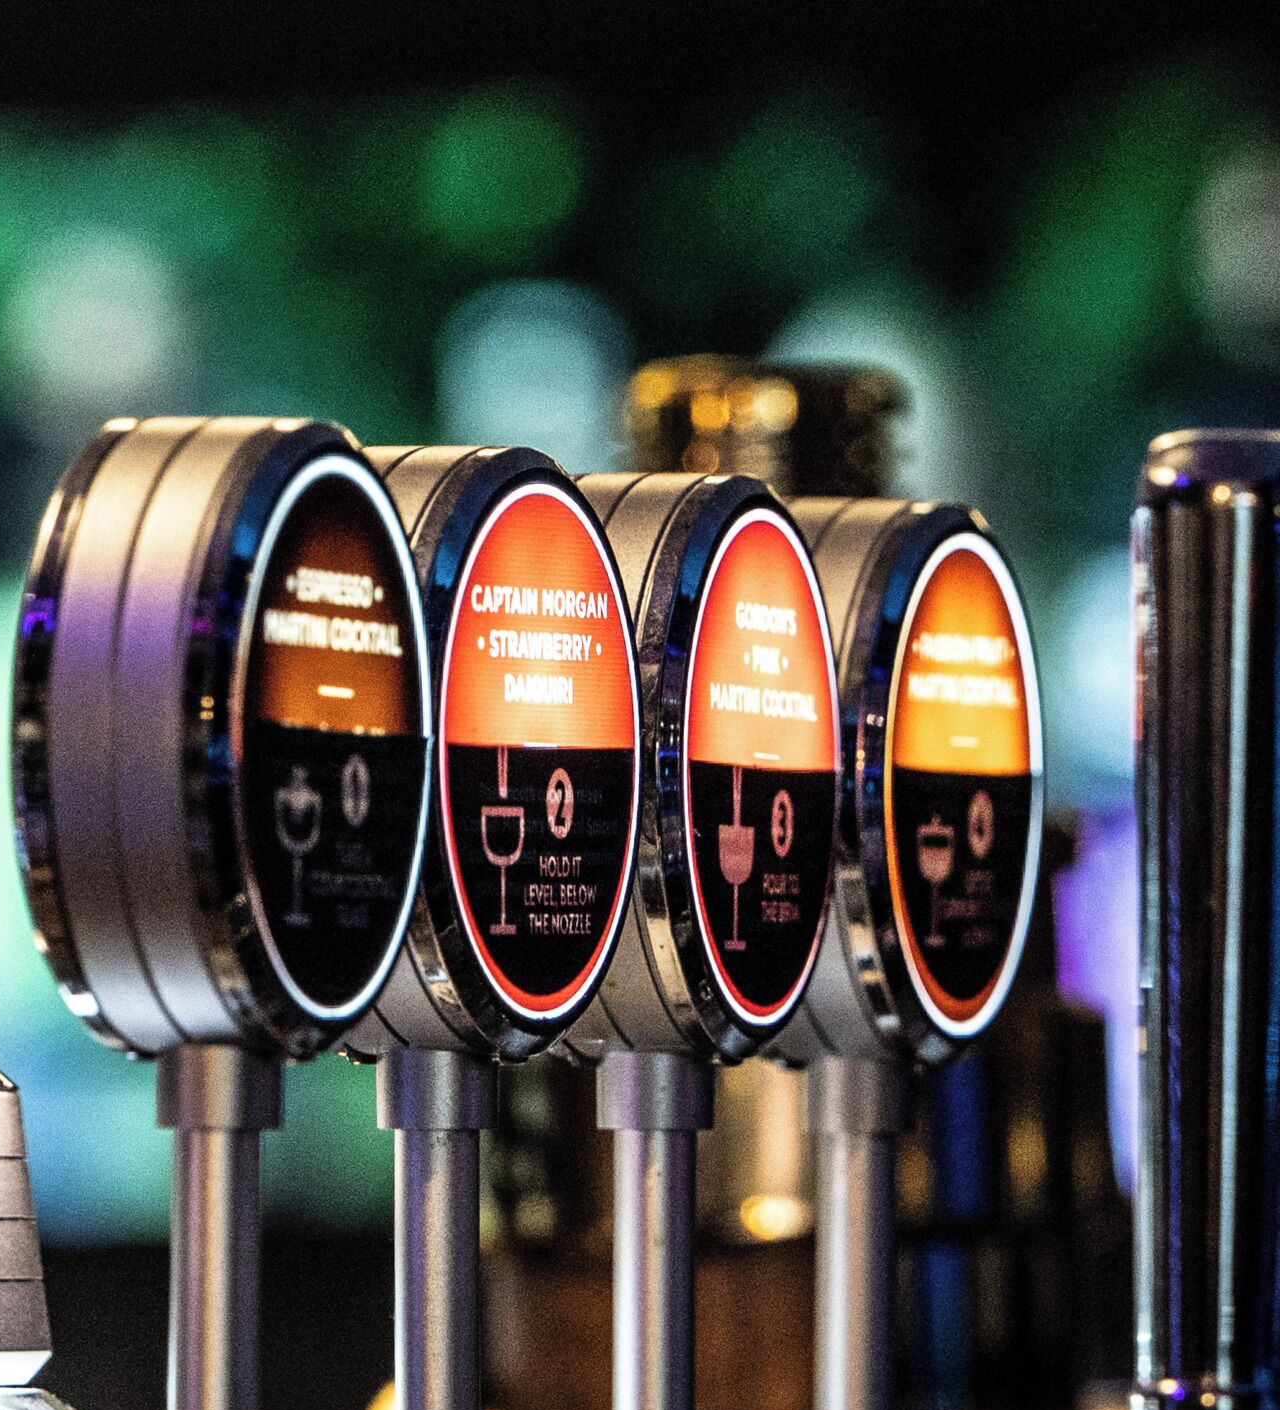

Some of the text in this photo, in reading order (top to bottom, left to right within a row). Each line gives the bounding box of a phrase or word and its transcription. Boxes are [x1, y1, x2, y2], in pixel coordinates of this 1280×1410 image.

[471, 584, 608, 619] CAPTAIN MORGAN
[489, 629, 592, 662] STRAWBERRY
[710, 682, 761, 714] MARTINI
[539, 855, 570, 878] HOLD
[572, 856, 582, 878] IT
[560, 884, 597, 906] BELOW
[529, 913, 592, 935] THE NOZZLE
